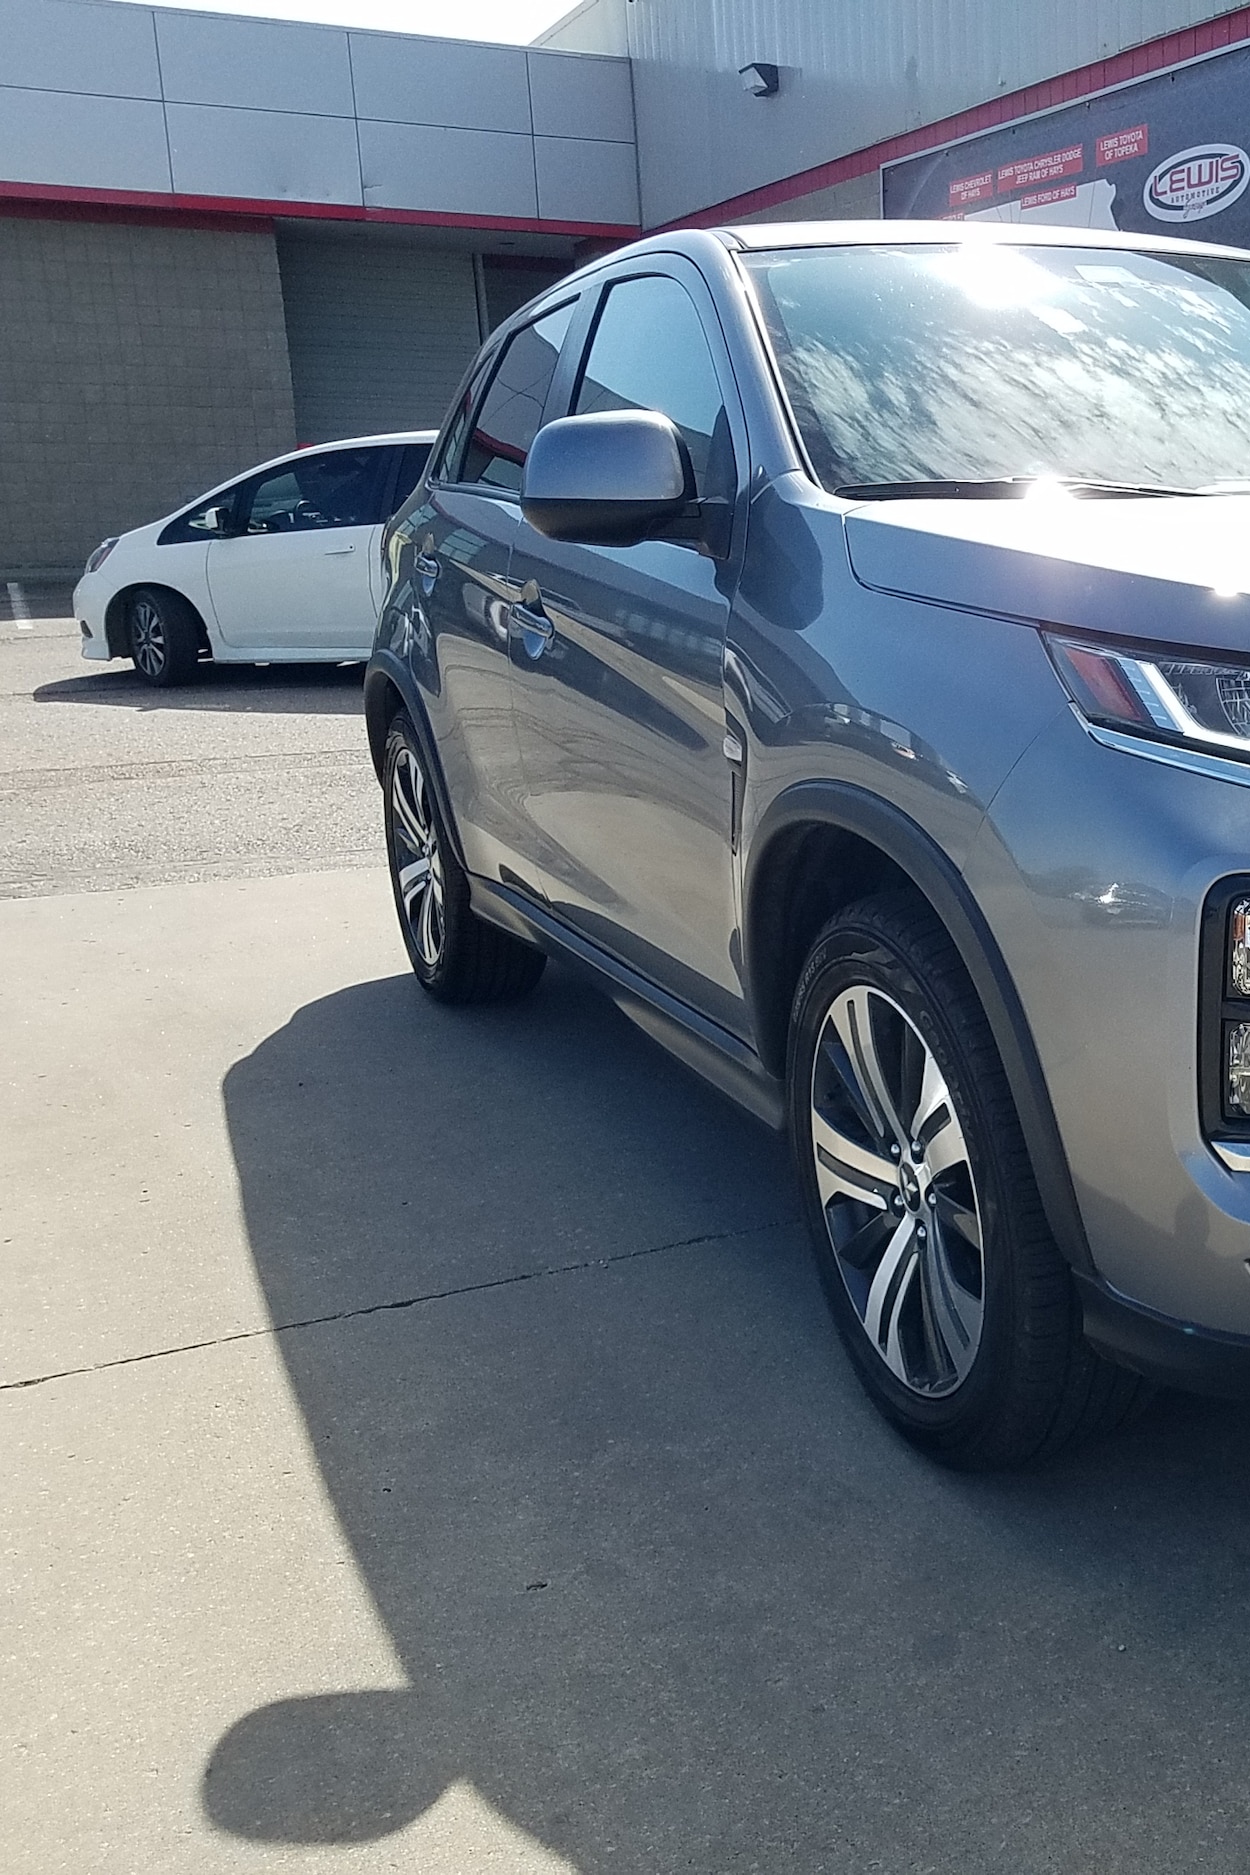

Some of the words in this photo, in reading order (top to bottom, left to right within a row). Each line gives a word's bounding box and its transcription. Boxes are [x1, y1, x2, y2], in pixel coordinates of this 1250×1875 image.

[1100, 138, 1118, 151] LEWIS
[1119, 130, 1143, 147] TOYOTA
[1105, 149, 1114, 160] OF
[1115, 143, 1138, 157] TOPEKA
[998, 166, 1013, 180] LEWIS
[1014, 161, 1034, 175] TOYOTA
[1034, 154, 1061, 169] CHRYSLER
[1062, 148, 1082, 162] DODGE
[1016, 173, 1029, 185] JEEP
[1030, 170, 1041, 182] RAM
[1041, 168, 1049, 179] OF
[1049, 164, 1063, 176] HAYS
[950, 182, 965, 194] LEWIS
[965, 174, 992, 190] CHEVROLET
[1153, 153, 1240, 197] LEWIS
[961, 191, 969, 200] OF
[969, 187, 980, 198] HAYS
[1021, 195, 1037, 207] LEWIS
[1037, 192, 1052, 204] FORD
[1052, 190, 1061, 201] OF
[1061, 185, 1075, 198] HAYS
[1171, 187, 1220, 203] AUTOMOTIVE
